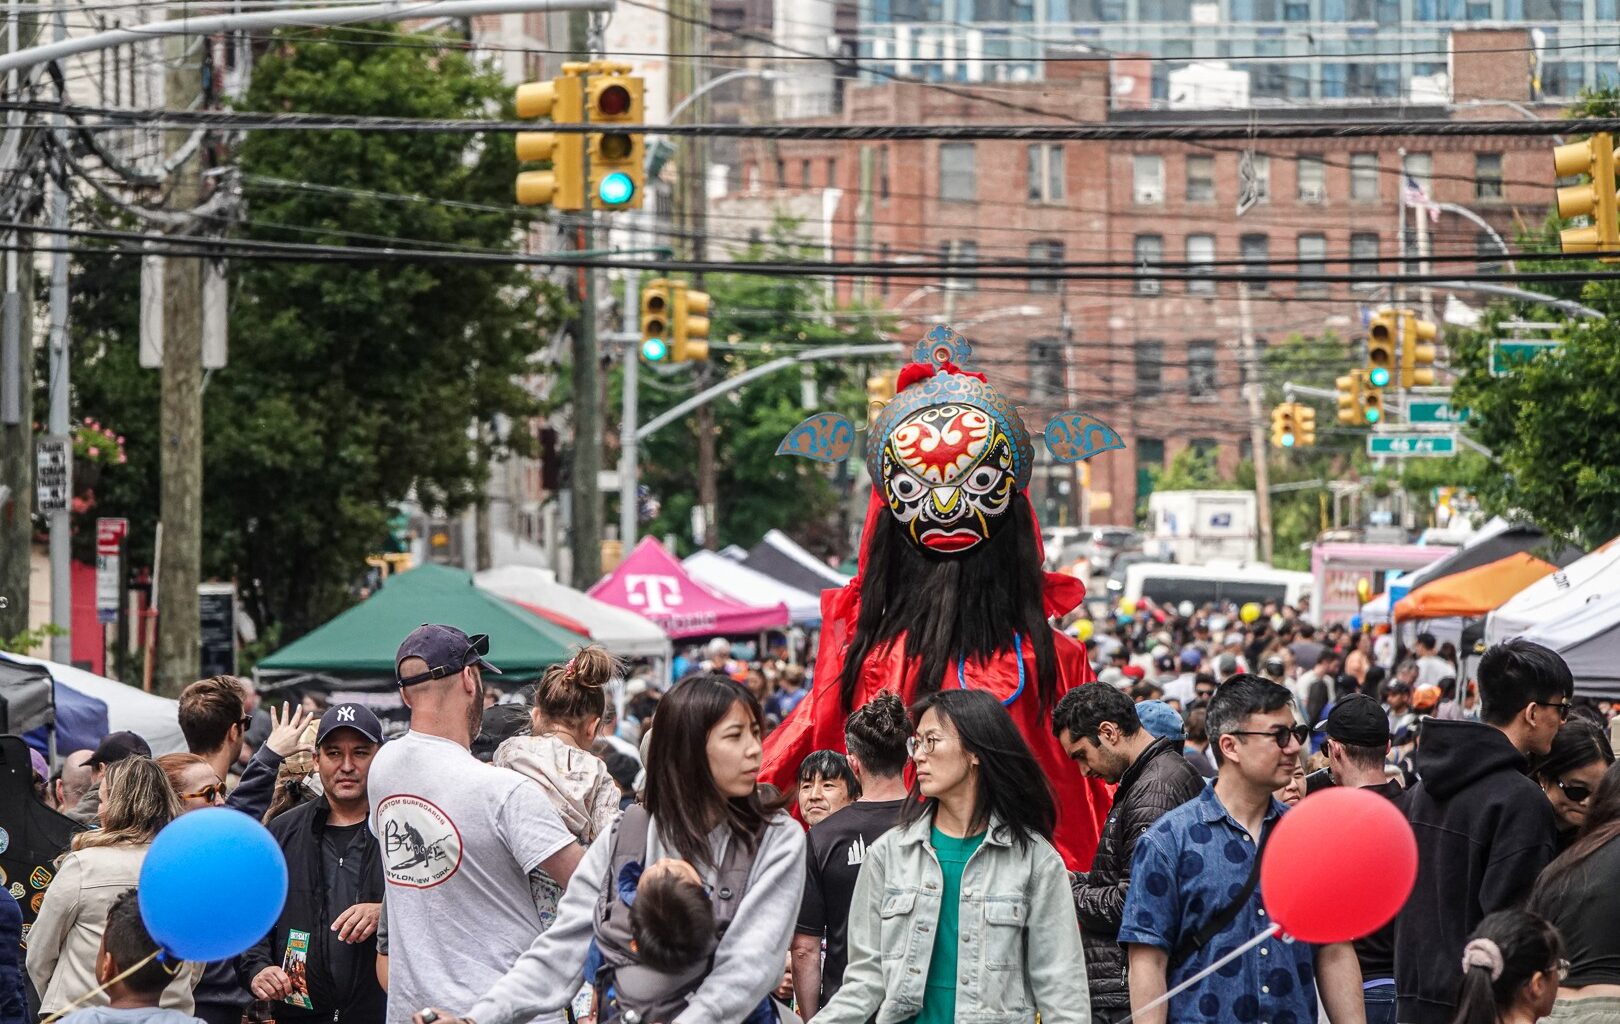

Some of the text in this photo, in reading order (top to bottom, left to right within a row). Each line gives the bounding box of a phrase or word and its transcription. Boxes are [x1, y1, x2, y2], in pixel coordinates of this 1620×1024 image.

[624, 574, 683, 614] T
[336, 705, 356, 722] NY
[379, 799, 446, 826] CUSTOM SURFBOARDS
[431, 866, 451, 880] YORK
